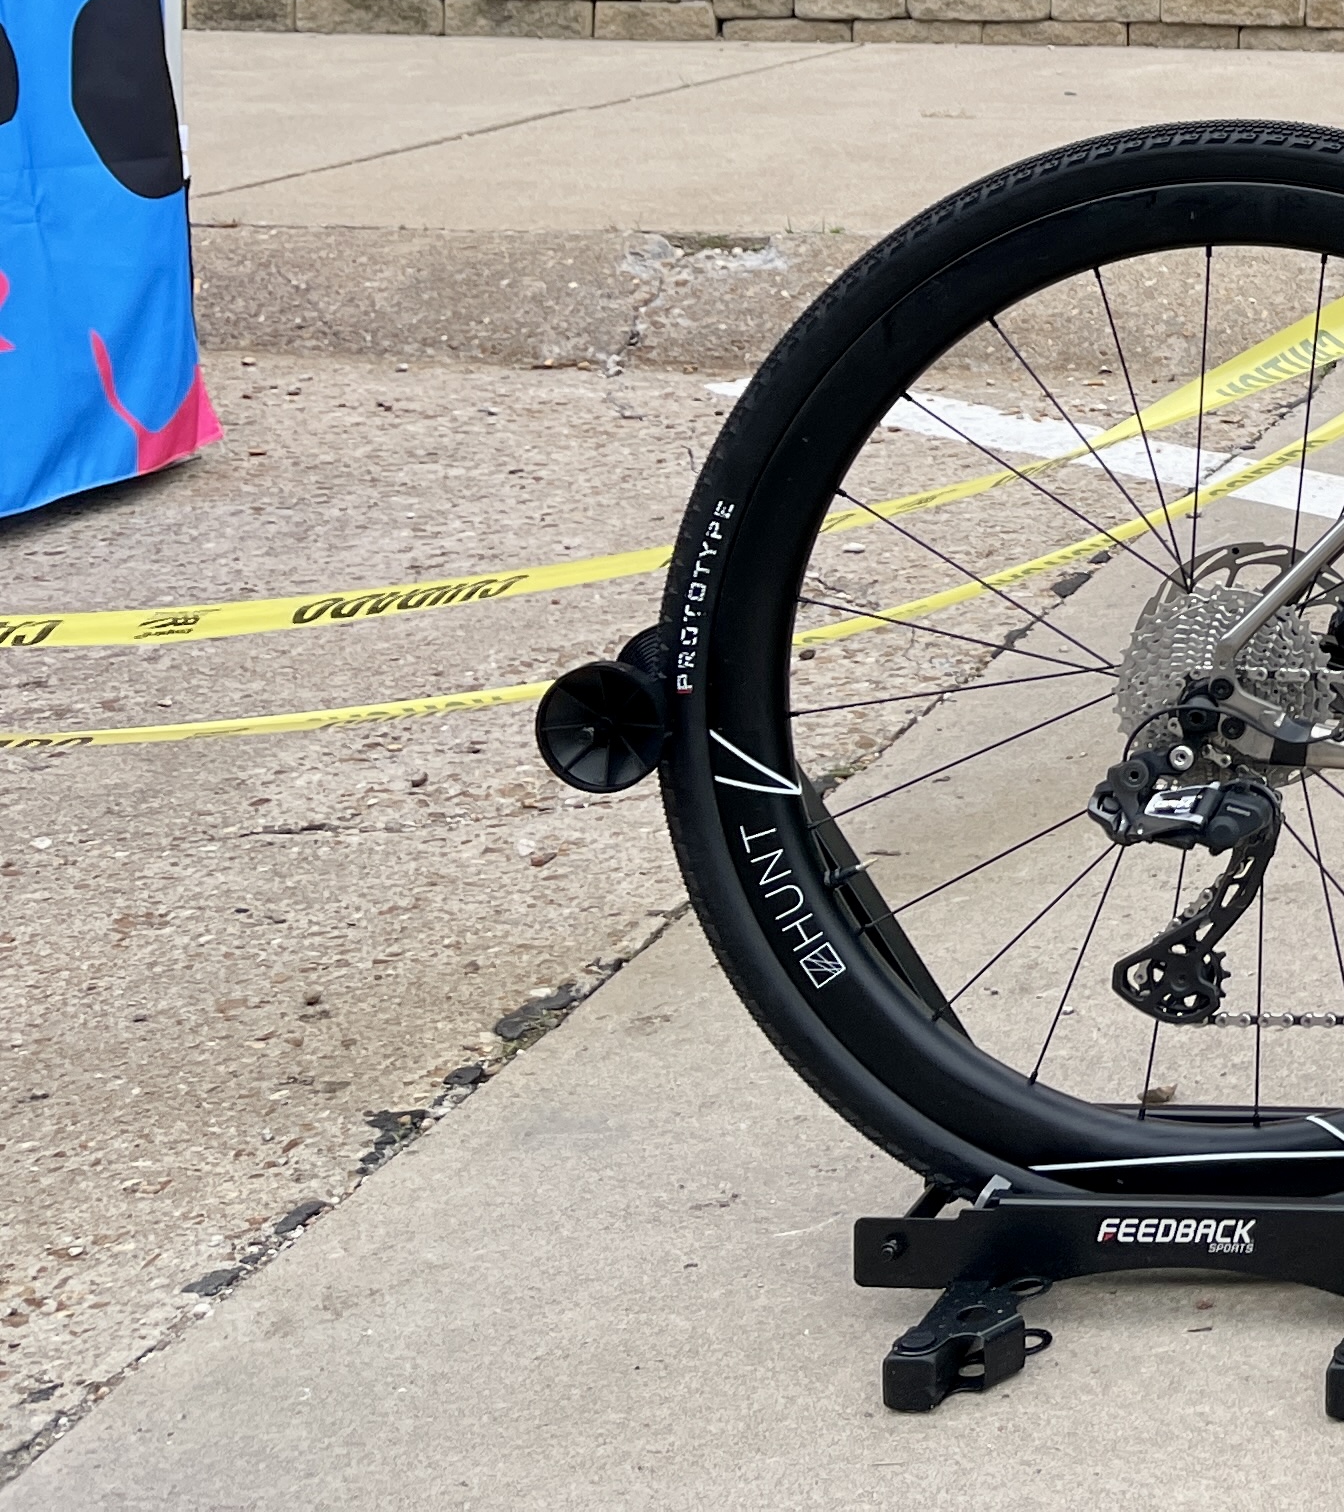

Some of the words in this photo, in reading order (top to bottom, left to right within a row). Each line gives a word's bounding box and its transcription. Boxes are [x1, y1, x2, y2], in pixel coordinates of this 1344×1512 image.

[676, 499, 736, 692] PROTOTYPE
[740, 823, 825, 953] HUNT
[1096, 1217, 1257, 1244] FEEDBACK
[1208, 1242, 1254, 1254] SPORTS
